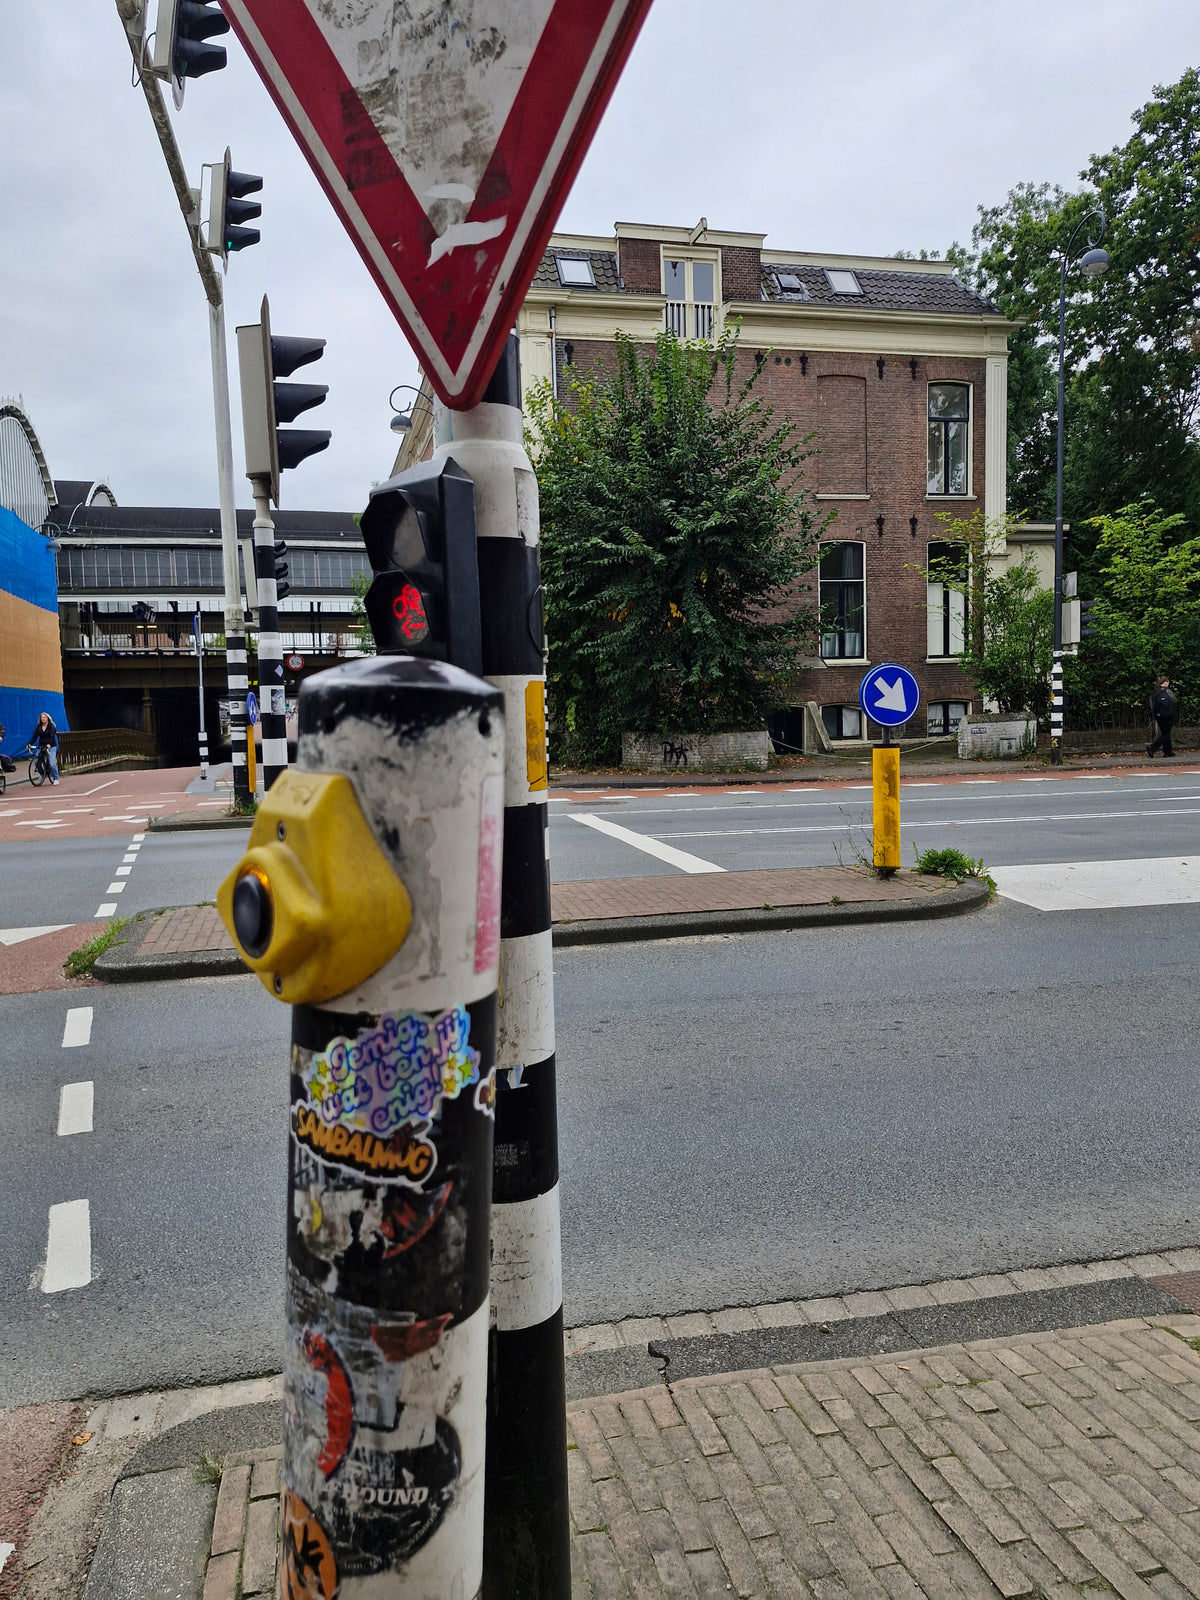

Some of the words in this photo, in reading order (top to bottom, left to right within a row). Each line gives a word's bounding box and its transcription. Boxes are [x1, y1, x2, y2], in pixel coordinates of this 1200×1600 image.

[322, 1075, 373, 1122] wat
[377, 1045, 433, 1091] ben
[434, 1009, 466, 1066] jij
[371, 1060, 443, 1132] enig!
